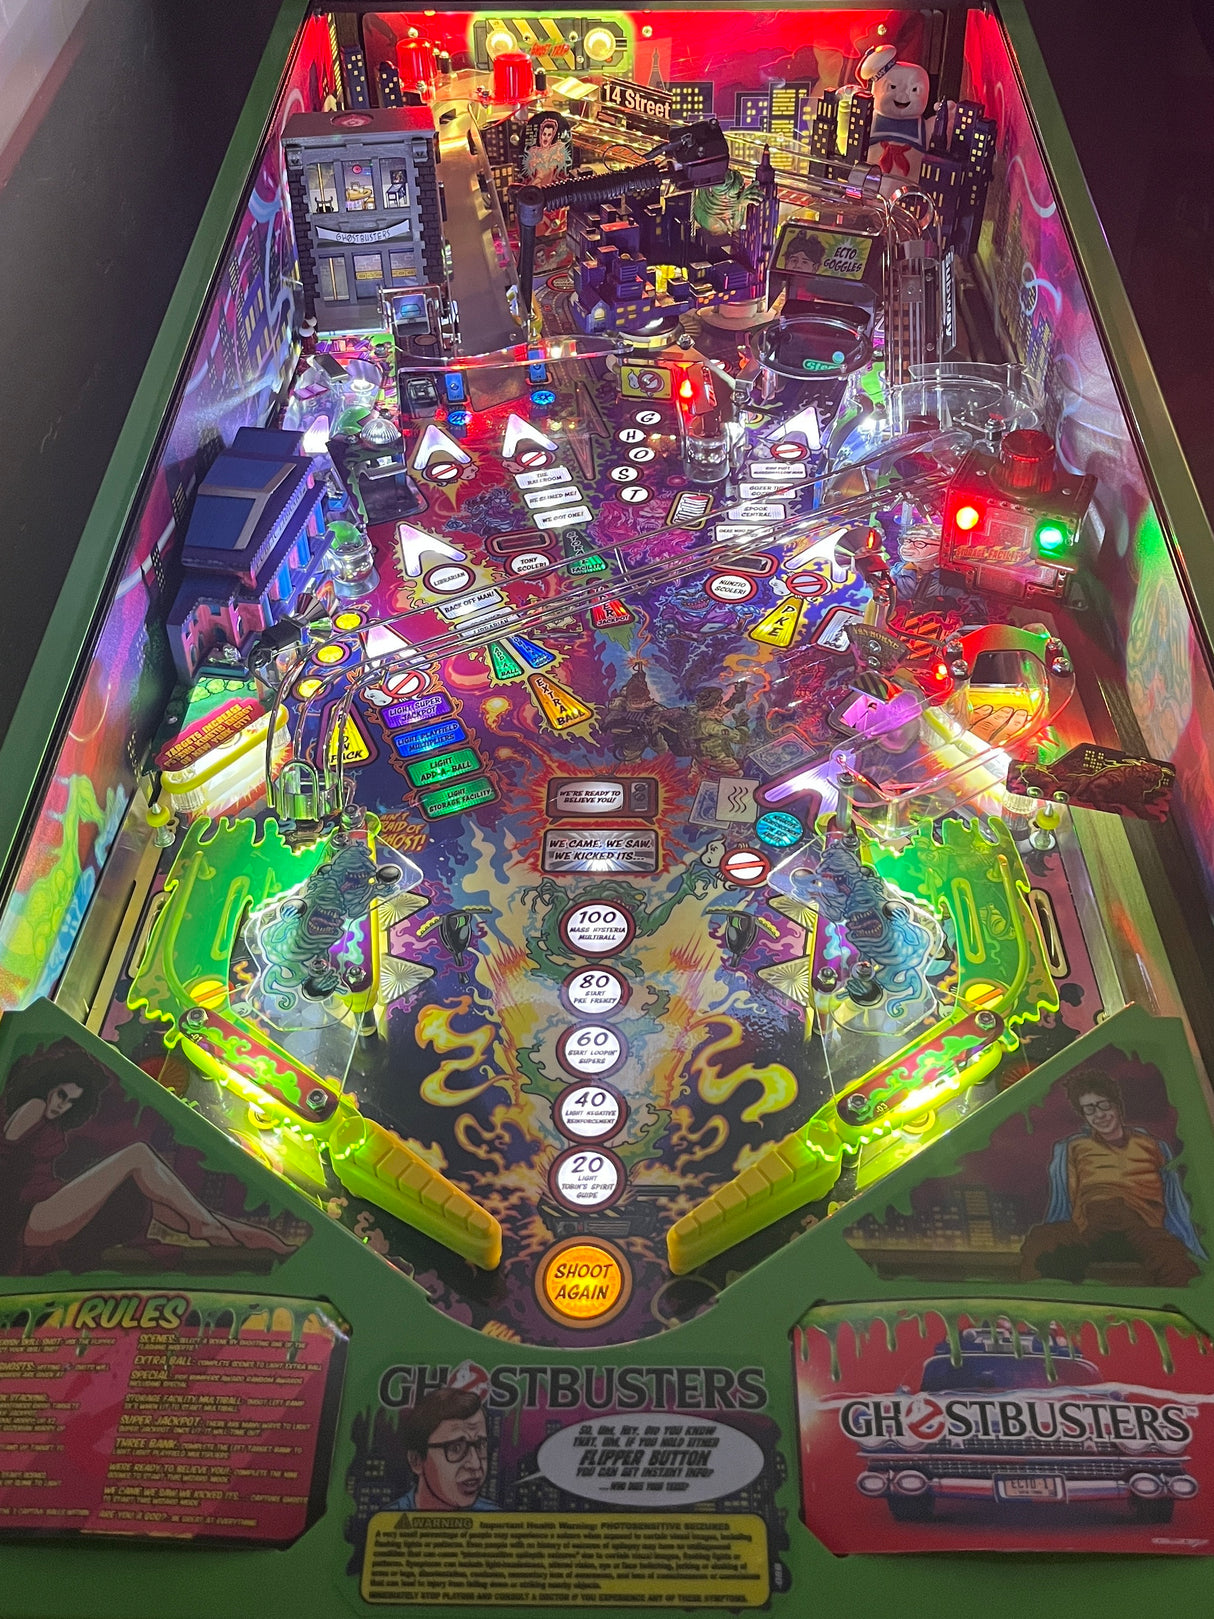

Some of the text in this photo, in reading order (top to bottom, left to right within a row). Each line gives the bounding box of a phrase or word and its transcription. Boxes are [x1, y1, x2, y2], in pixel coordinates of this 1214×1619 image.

[604, 84, 671, 119] 14 Street
[833, 247, 857, 259] ECTO
[823, 258, 862, 273] GOGGLES
[520, 557, 537, 565] TONY
[718, 579, 747, 588] NUNZIO
[714, 586, 748, 596] SCOLERI
[444, 591, 495, 613] BACK OFF MAN!
[597, 615, 630, 626] JACKPOT
[768, 604, 796, 637] PKE
[501, 669, 518, 677] BALL
[536, 679, 568, 714] EXTRA
[389, 696, 442, 716] LIGHT SUPER
[223, 704, 254, 727] ENERGY
[402, 706, 437, 722] JACKPOT
[557, 711, 585, 726] BALL
[232, 714, 252, 729] CITY
[164, 731, 203, 758] TARGETS
[429, 757, 453, 769] LIGHT
[447, 788, 466, 798] LIGHT
[429, 799, 462, 813] STORAGE
[405, 823, 422, 834] OF
[549, 839, 568, 848] WE
[606, 839, 624, 848] WE
[555, 851, 645, 861] WE KICKED ITS...
[579, 911, 617, 924] 100
[579, 974, 610, 989] 80
[576, 1031, 609, 1047] 60
[574, 1091, 607, 1107] 40
[571, 1155, 604, 1174] 20
[576, 1191, 599, 1199] GUIDE
[554, 1263, 613, 1279] SHOOT
[554, 1284, 610, 1300] AGAIN
[75, 1294, 191, 1329] RULES
[134, 1355, 167, 1365] EXTRA
[119, 1415, 153, 1425] SUPER
[841, 1396, 1192, 1443] GHOSTBUSTERS
[664, 1425, 683, 1436] YOU
[115, 1438, 147, 1447] THREE
[638, 1437, 658, 1447] YOU
[578, 1449, 712, 1466] FLIPPER BUTTON
[576, 1467, 596, 1477] YOU
[412, 1517, 473, 1529] WARNING
